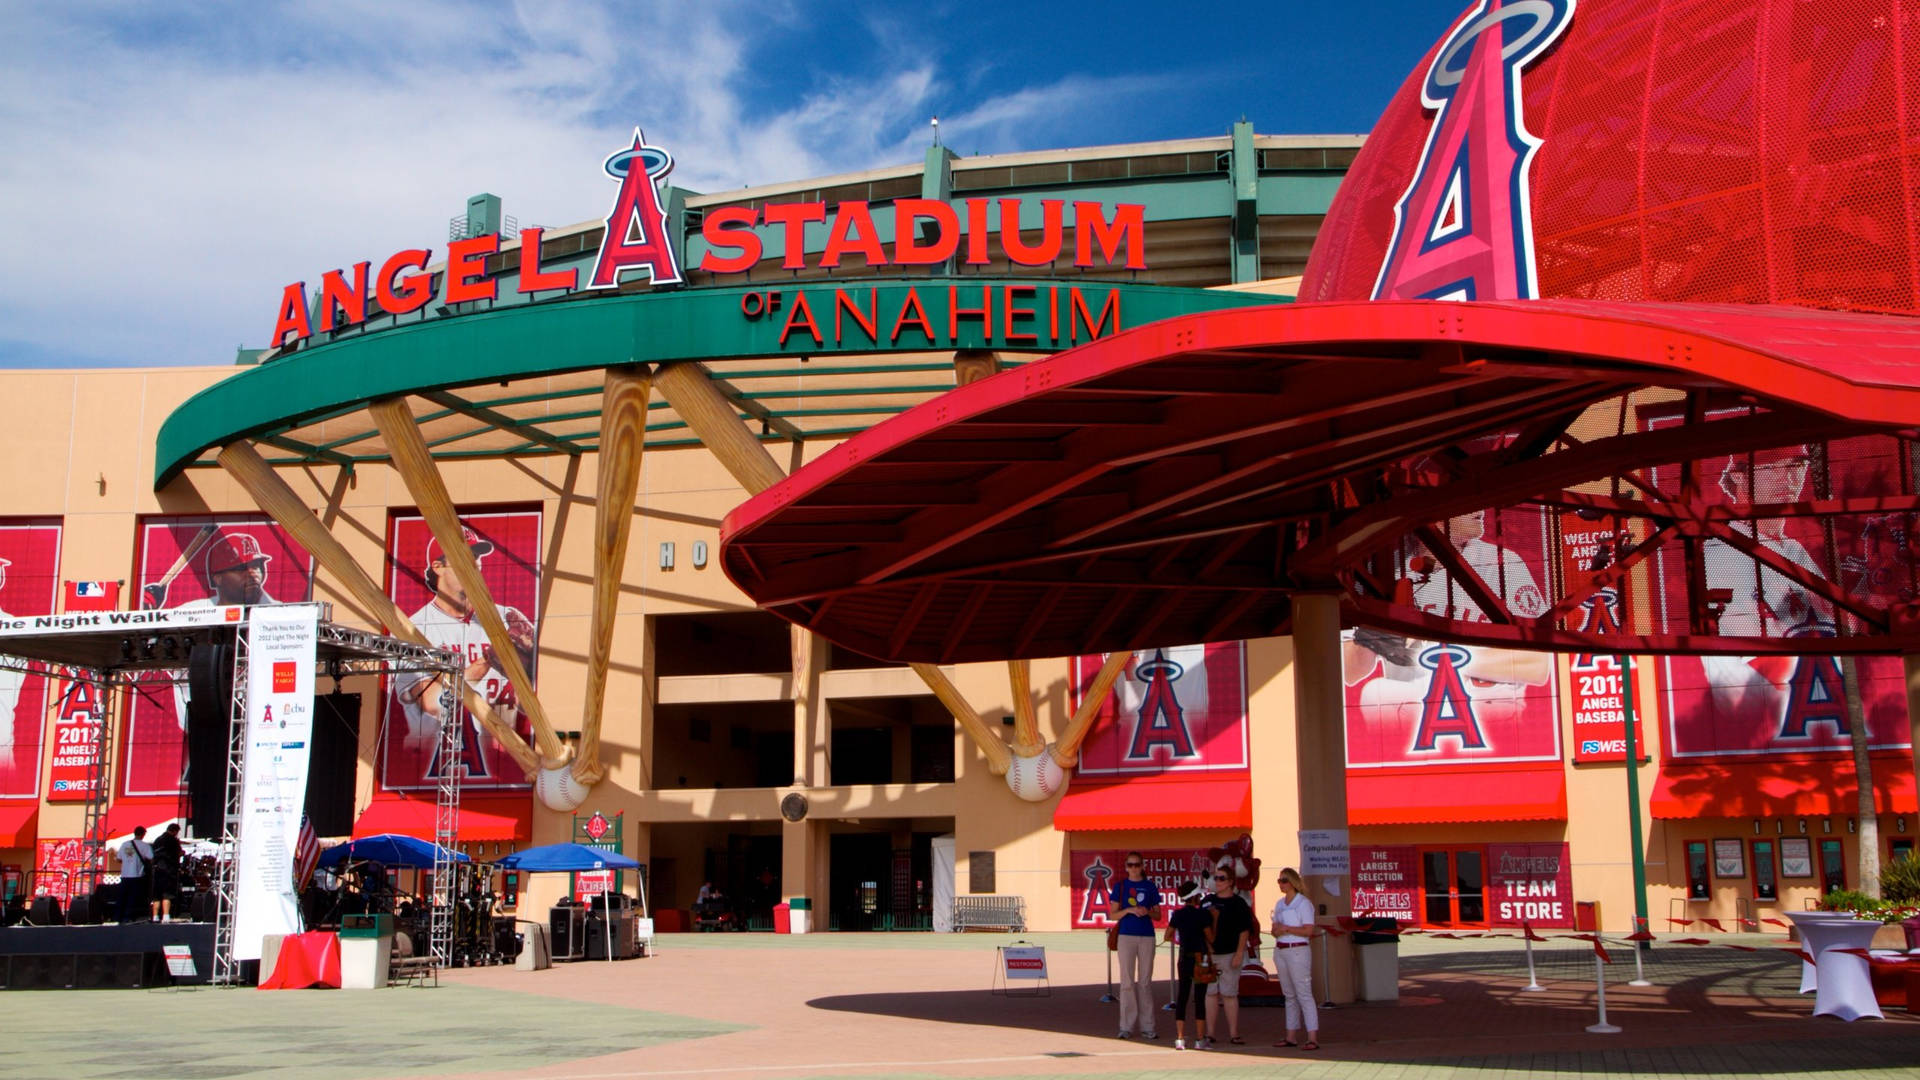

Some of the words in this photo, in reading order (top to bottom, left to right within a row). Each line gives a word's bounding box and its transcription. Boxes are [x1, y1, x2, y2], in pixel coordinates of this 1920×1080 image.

[271, 227, 578, 349] ANGEL
[588, 127, 685, 290] A
[699, 198, 1148, 273] STADIUM
[740, 291, 781, 319] OF
[778, 285, 1121, 346] ANAHEIM
[660, 541, 707, 568] HO
[35, 615, 100, 629] Night
[115, 610, 169, 625] Walk
[486, 678, 516, 710] 24
[1582, 696, 1623, 710] ANGEL
[1576, 710, 1640, 724] BASEBAL
[59, 727, 100, 743] 2012
[59, 745, 97, 755] ANGELS
[1754, 818, 1906, 835] TICKES
[1372, 852, 1388, 860] THE
[1500, 851, 1560, 873] ANGELS
[1143, 858, 1186, 872] FICIAL
[1361, 862, 1399, 871] LARGEST
[1358, 873, 1403, 882] SELECTION
[1375, 884, 1386, 892] OF
[1504, 880, 1557, 897] TEAM
[1354, 888, 1411, 910] ANGELS
[1351, 911, 1413, 920] MCHANDISE
[1500, 902, 1563, 920] STORE
